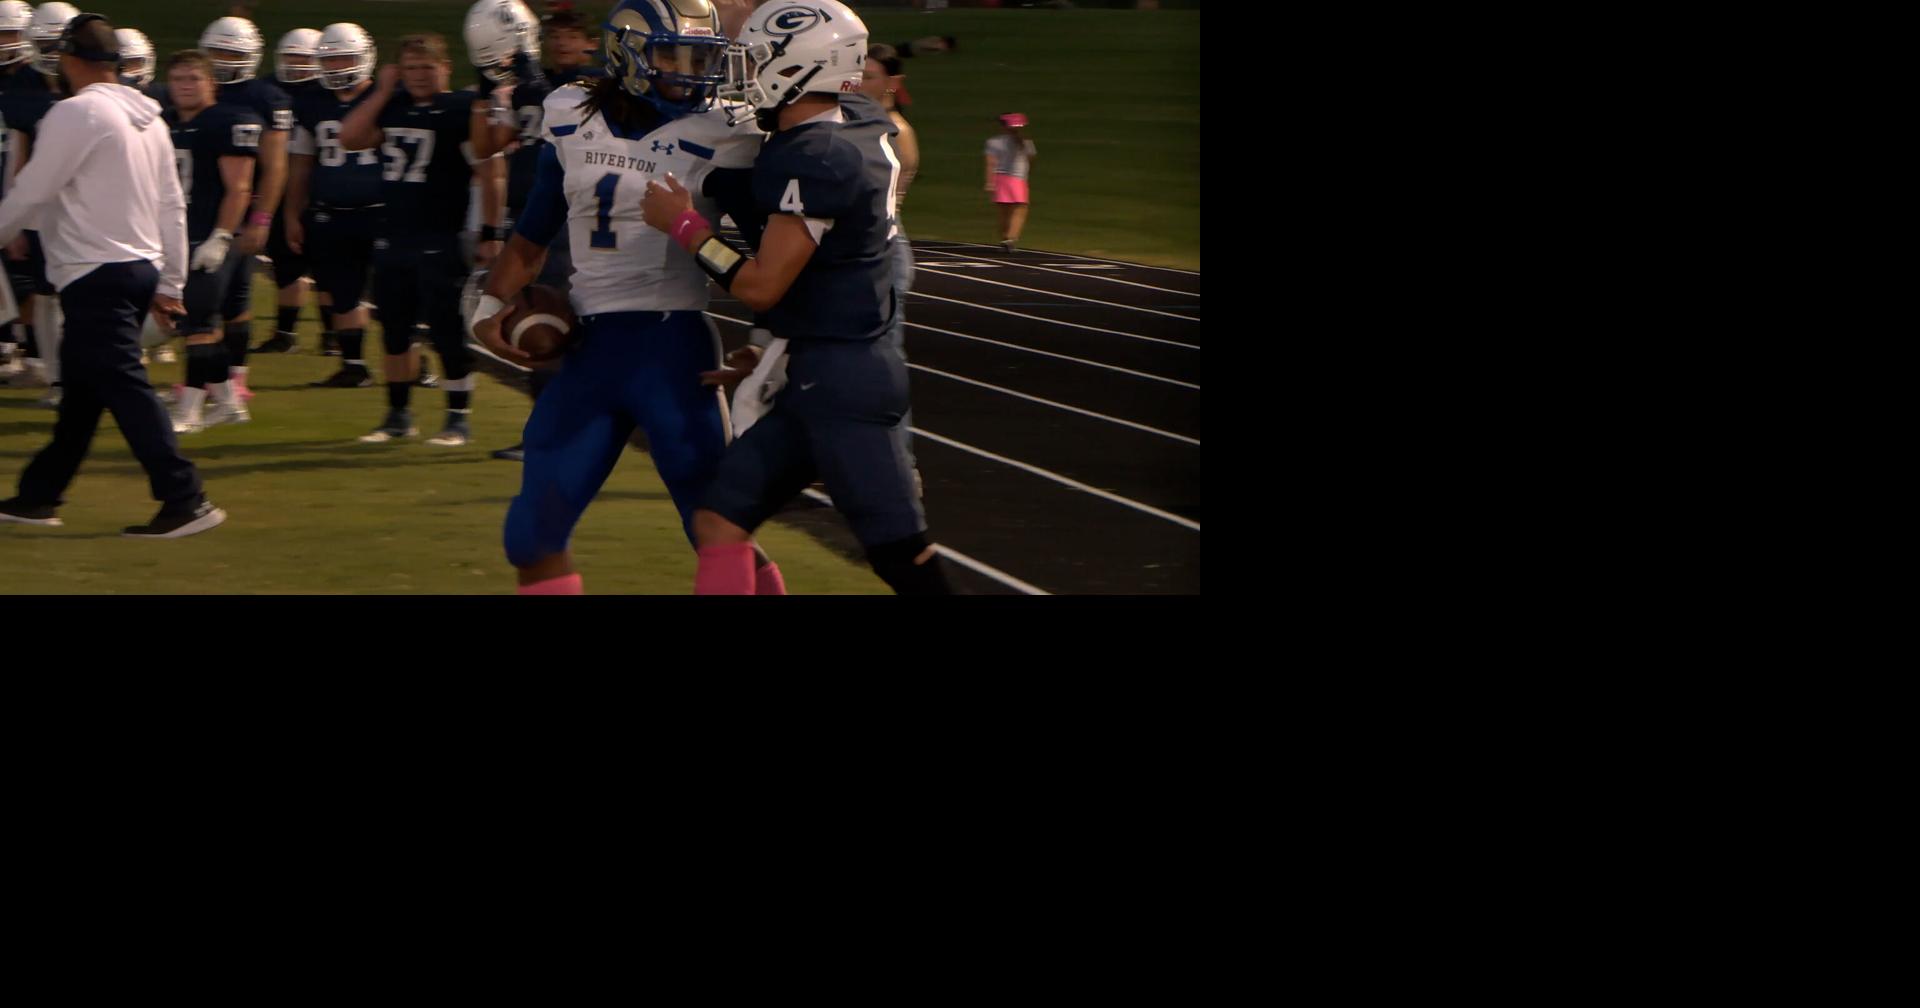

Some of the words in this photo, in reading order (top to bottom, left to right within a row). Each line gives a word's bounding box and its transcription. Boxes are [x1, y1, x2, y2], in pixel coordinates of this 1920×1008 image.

[774, 10, 817, 30] G
[381, 127, 437, 182] 57
[585, 151, 656, 173] RIVERTON
[590, 173, 619, 252] 1
[778, 178, 804, 214] 4
